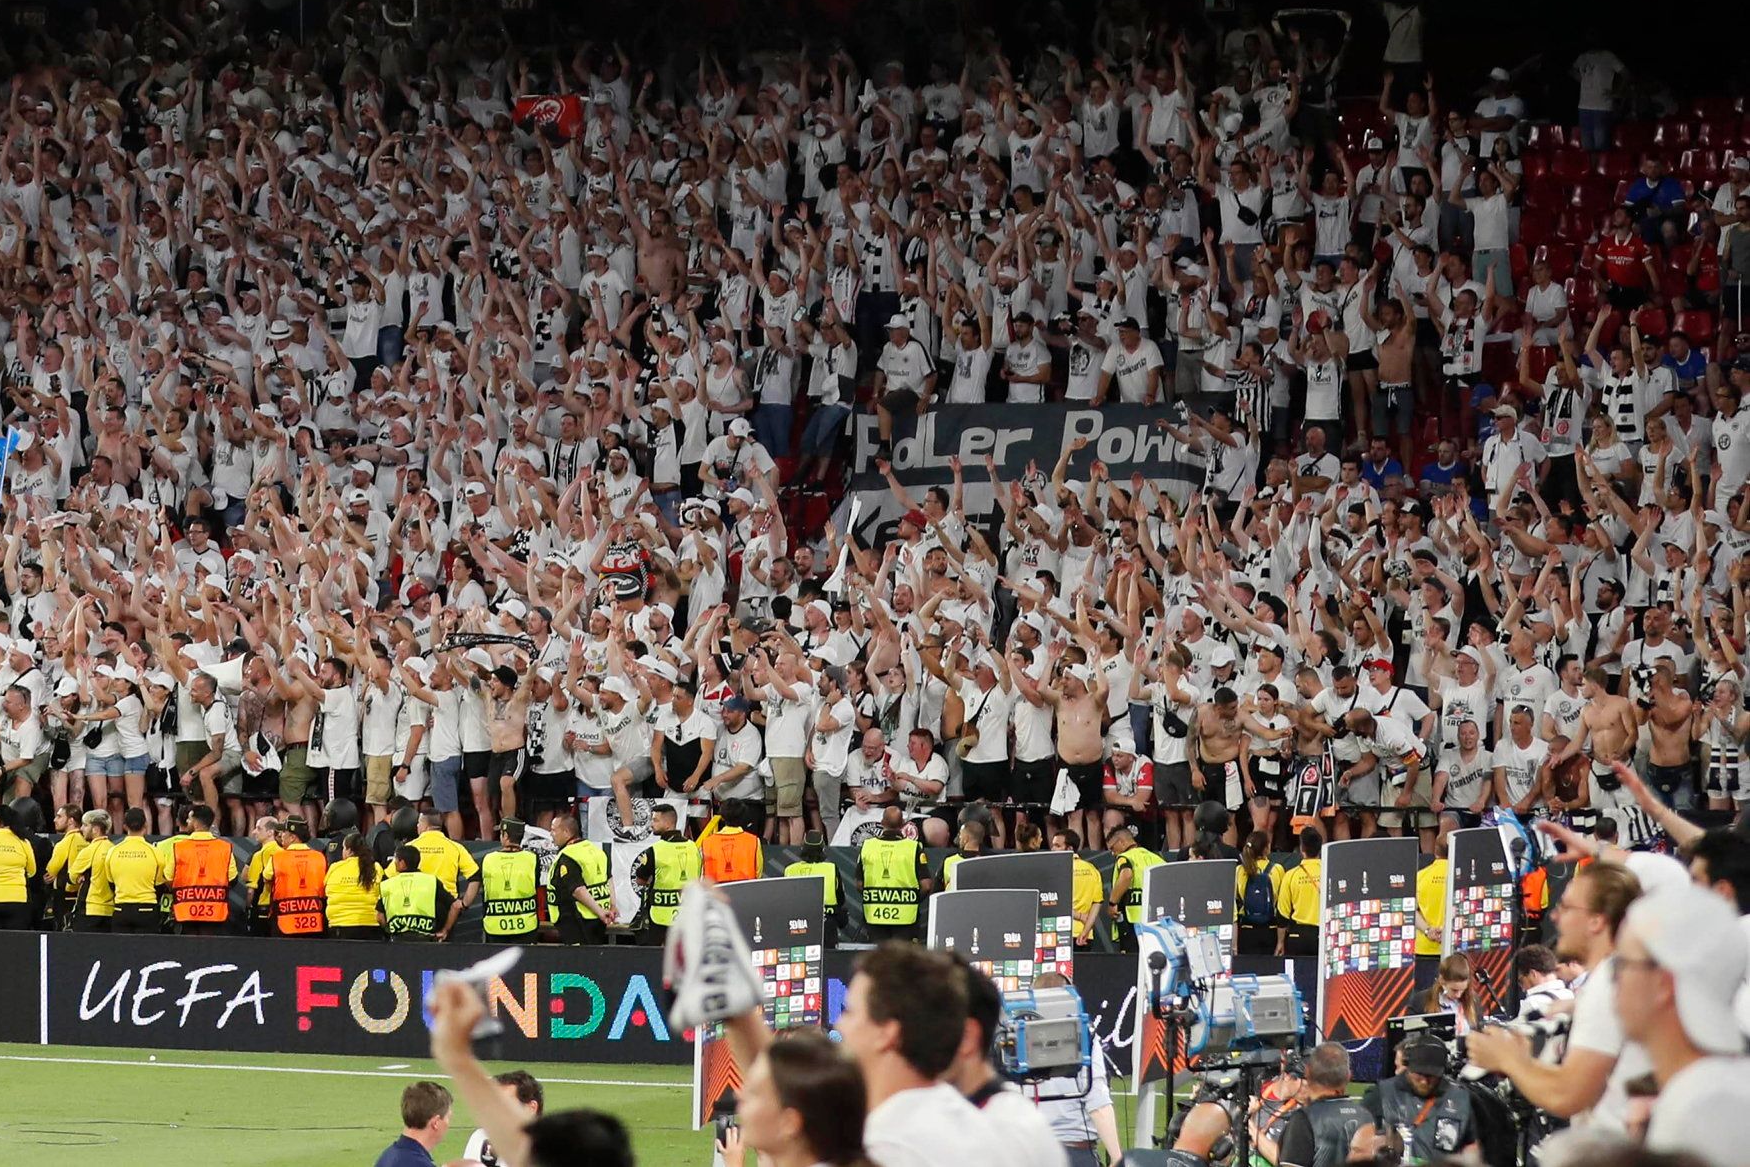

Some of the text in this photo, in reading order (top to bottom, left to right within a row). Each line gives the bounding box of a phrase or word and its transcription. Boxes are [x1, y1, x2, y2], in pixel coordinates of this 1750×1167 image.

[189, 904, 215, 917] 023
[873, 907, 901, 920] 462
[294, 917, 318, 929] 328
[499, 917, 526, 931] 018
[78, 959, 274, 1030] UEFA
